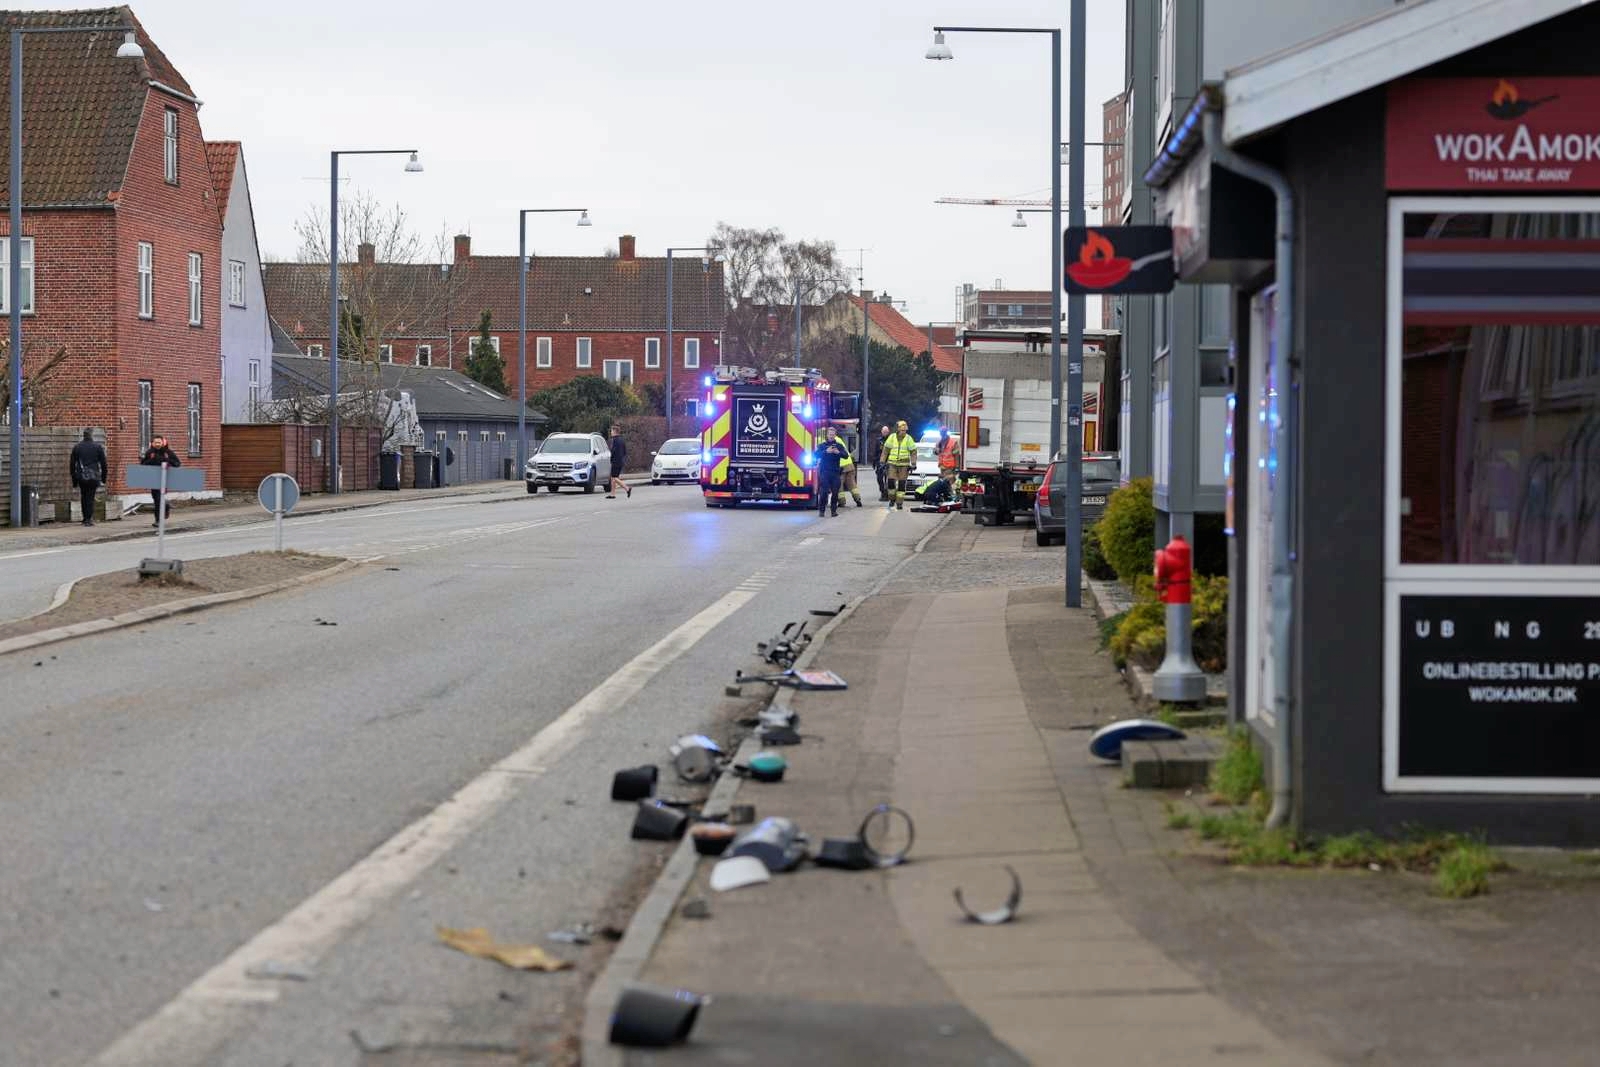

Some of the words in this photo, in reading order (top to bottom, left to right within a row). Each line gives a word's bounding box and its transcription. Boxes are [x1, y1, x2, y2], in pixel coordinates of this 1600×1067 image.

[1434, 123, 1600, 162] WOKAMOK
[1466, 167, 1499, 182] THAI
[1502, 167, 1533, 182] TAKE
[1536, 167, 1573, 182] AWAY
[1423, 661, 1584, 681] ONLINEBESTILLING
[1468, 685, 1578, 703] WOKAMOK.DK
